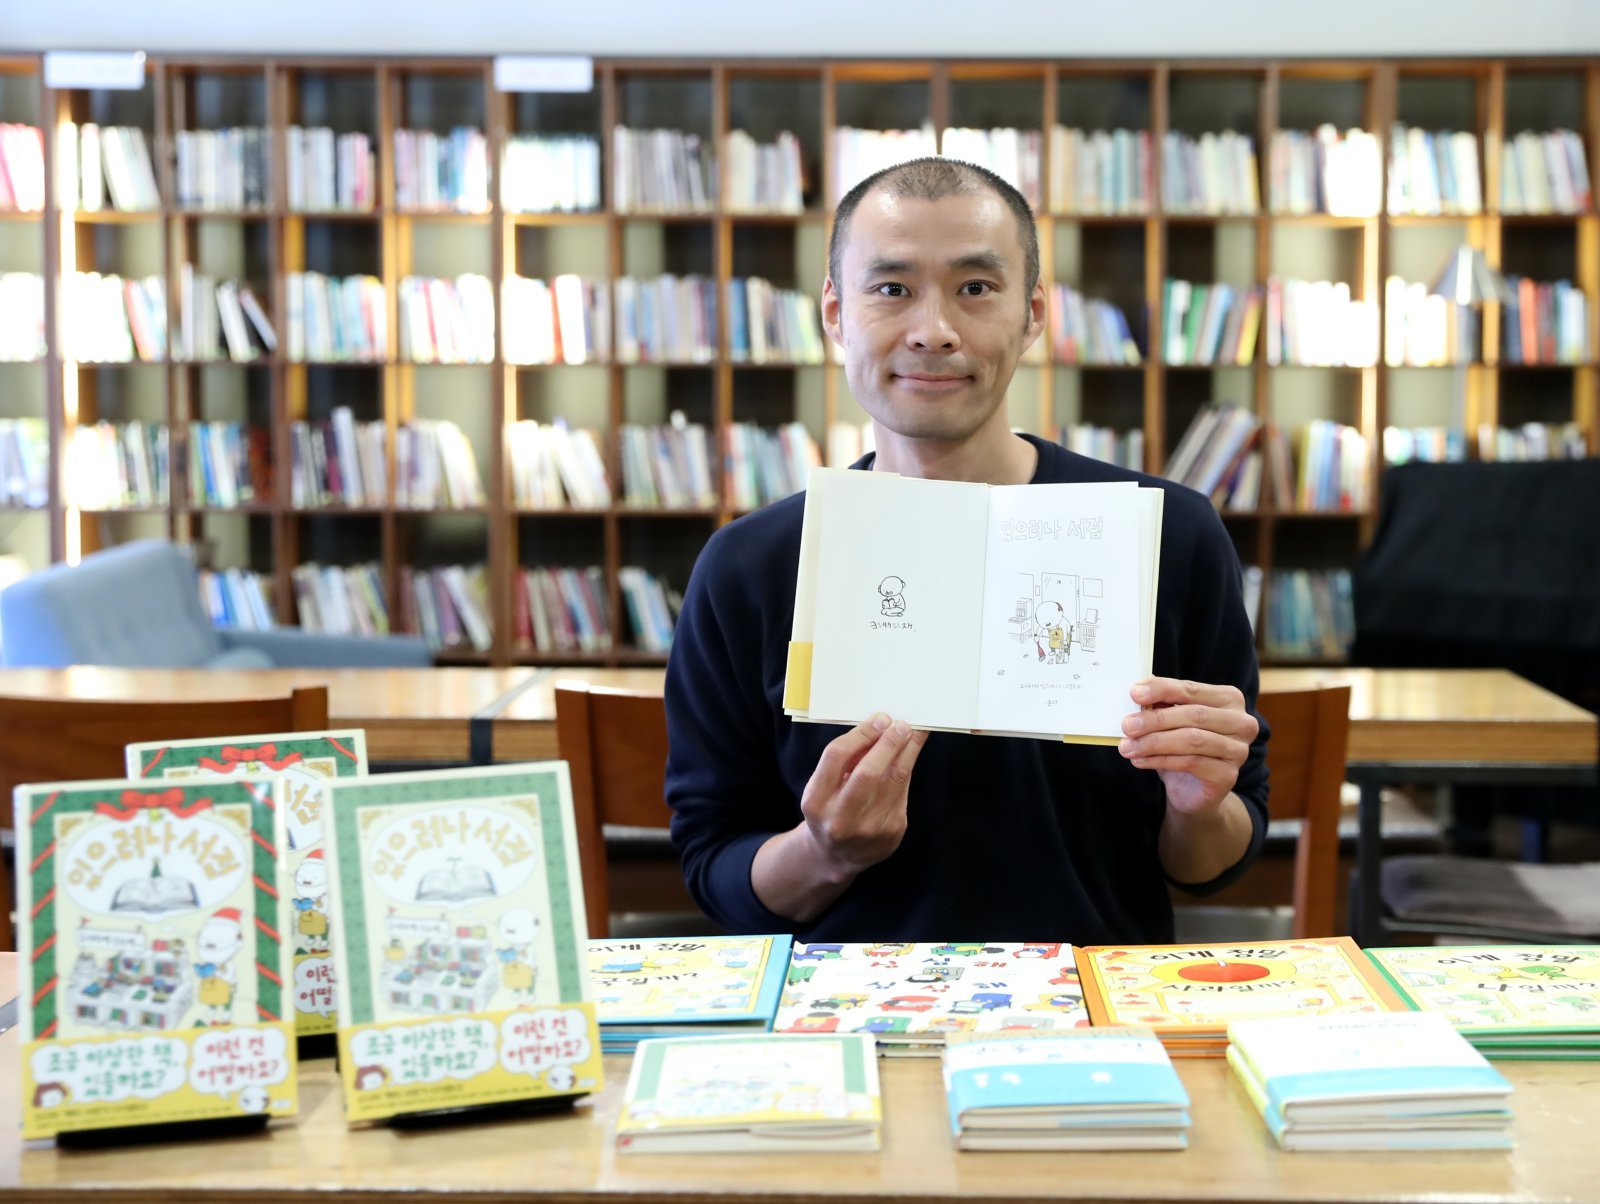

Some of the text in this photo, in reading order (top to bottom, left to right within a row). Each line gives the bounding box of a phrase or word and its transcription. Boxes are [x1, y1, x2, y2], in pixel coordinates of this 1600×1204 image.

[1000, 516, 1104, 543] 있으려나 서점
[178, 828, 242, 881] 서점
[473, 816, 534, 868] 서점
[1149, 949, 1290, 960] 이게 정말
[1437, 952, 1584, 965] 이게 정말
[1163, 980, 1296, 993] 사과일까?
[366, 1035, 397, 1056] 조금
[402, 1026, 456, 1051] 이상한
[513, 1019, 546, 1040] 이런
[46, 1050, 79, 1073] 조금
[85, 1043, 145, 1069] 이상한
[206, 1037, 241, 1060] 이런
[507, 1039, 583, 1065] 어떨까요?
[197, 1060, 280, 1086] 어떨까요?
[401, 1050, 479, 1079] 있을까요?
[83, 1069, 167, 1098] 있을까요?
